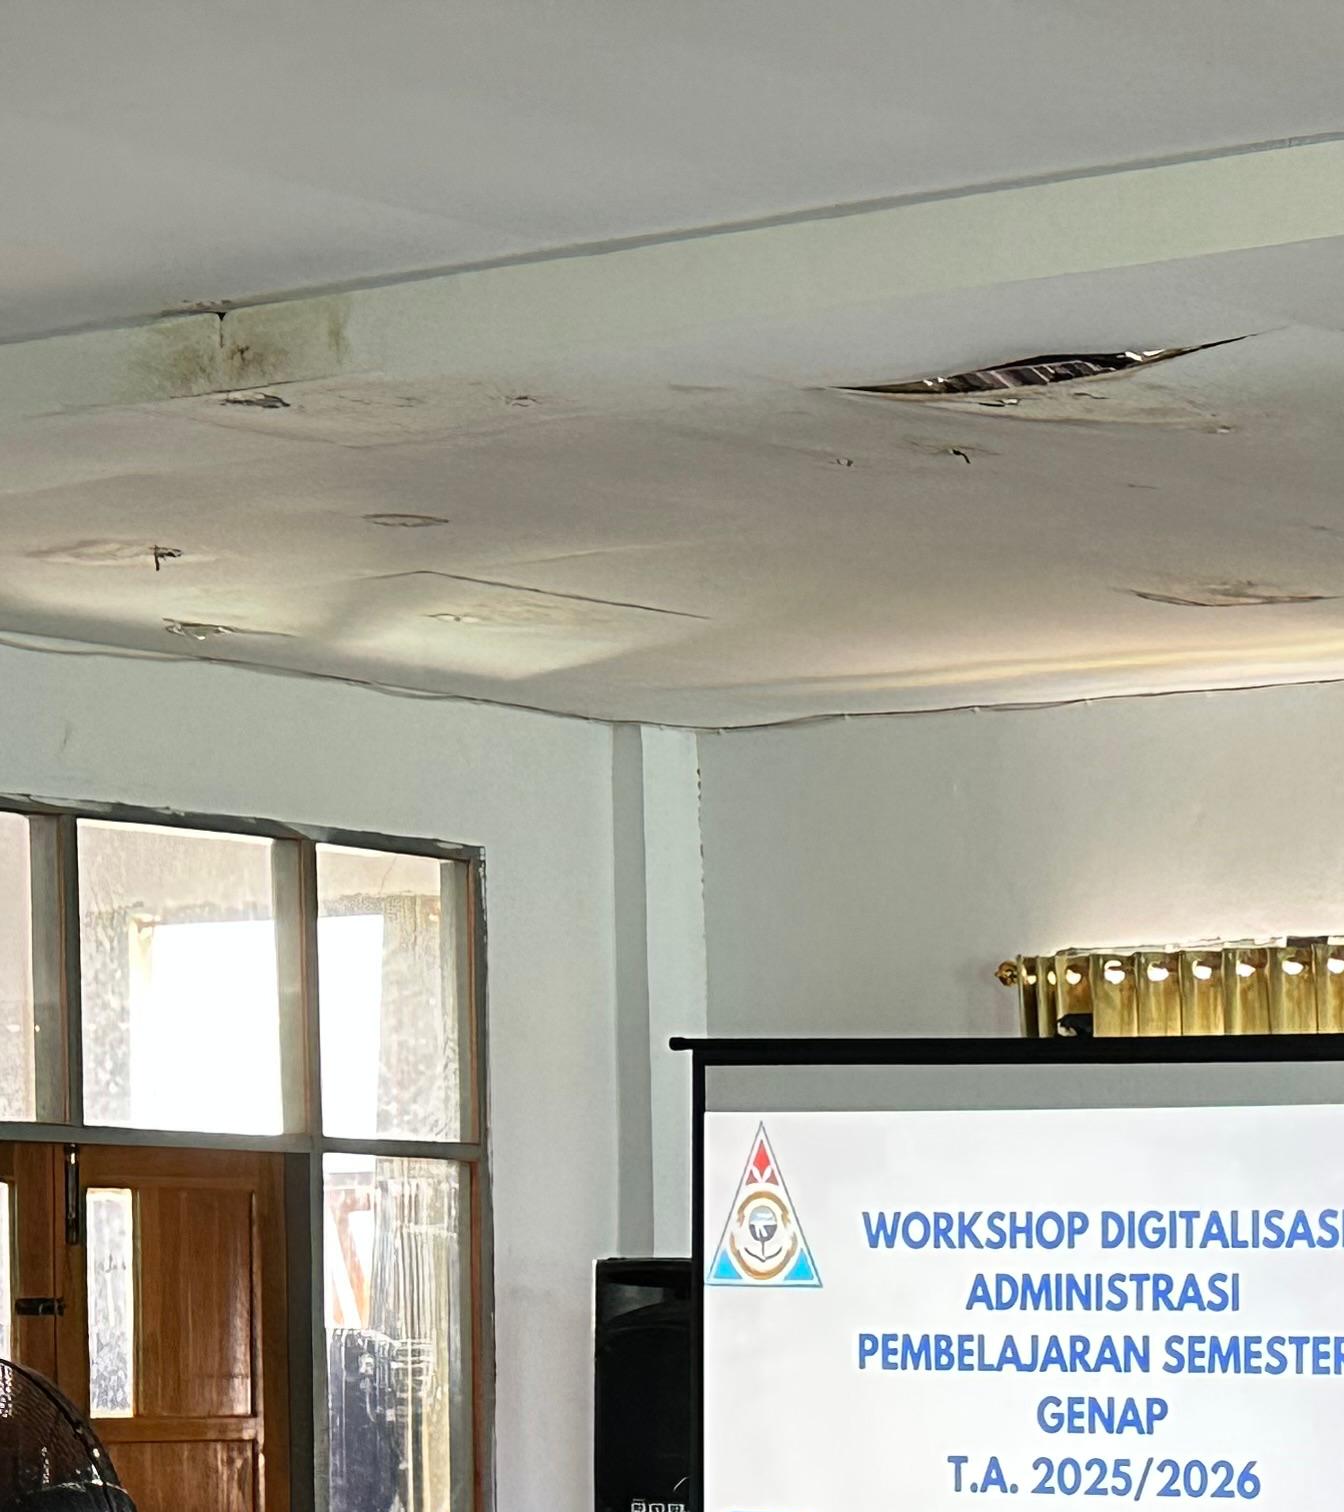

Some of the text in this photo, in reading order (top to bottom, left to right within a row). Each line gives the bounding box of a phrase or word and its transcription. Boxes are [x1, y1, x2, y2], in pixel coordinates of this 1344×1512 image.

[862, 1211, 1089, 1250] WORKSHOP
[966, 1273, 1240, 1312] ADMINISTRASI
[858, 1333, 1150, 1374] PEMBELAJARAN
[1037, 1395, 1169, 1436] GENAP
[947, 1455, 1262, 1501] T.A. 2025/2026
